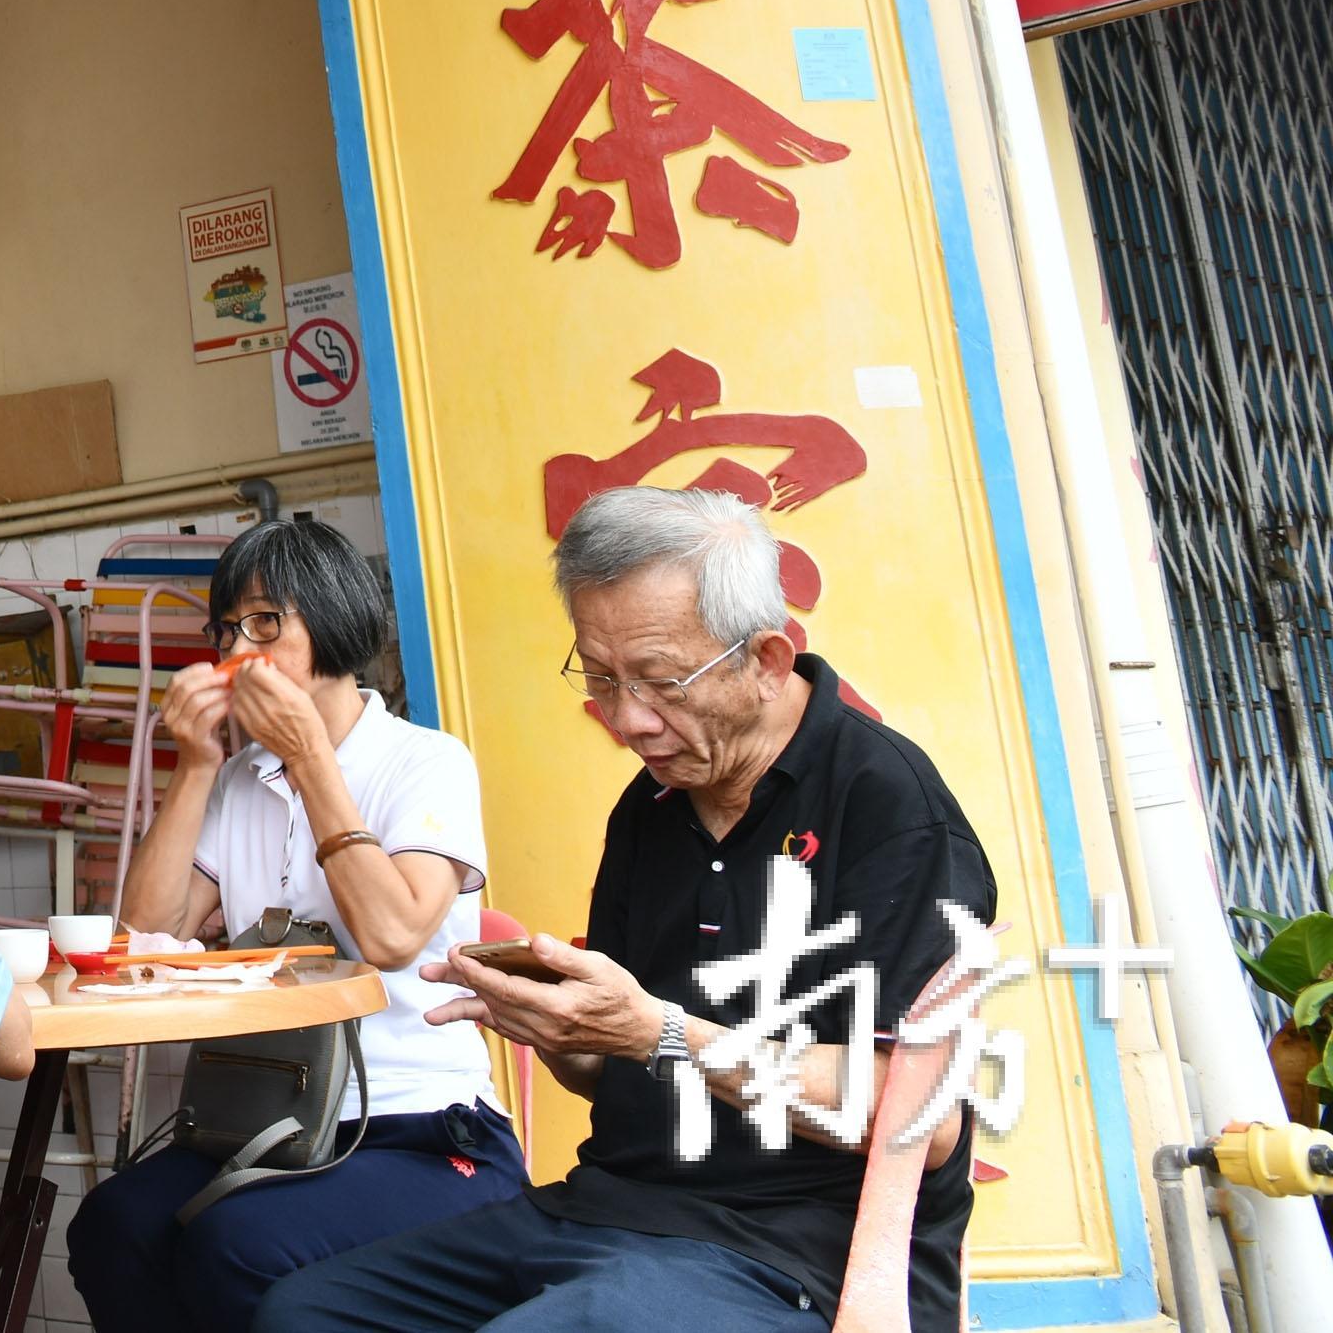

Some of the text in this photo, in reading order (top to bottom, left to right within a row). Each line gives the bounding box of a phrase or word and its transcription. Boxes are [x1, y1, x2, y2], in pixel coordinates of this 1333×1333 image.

[192, 206, 263, 234] DILARANG
[193, 221, 264, 249] MEROKOK
[293, 285, 331, 298] NO SMOKING
